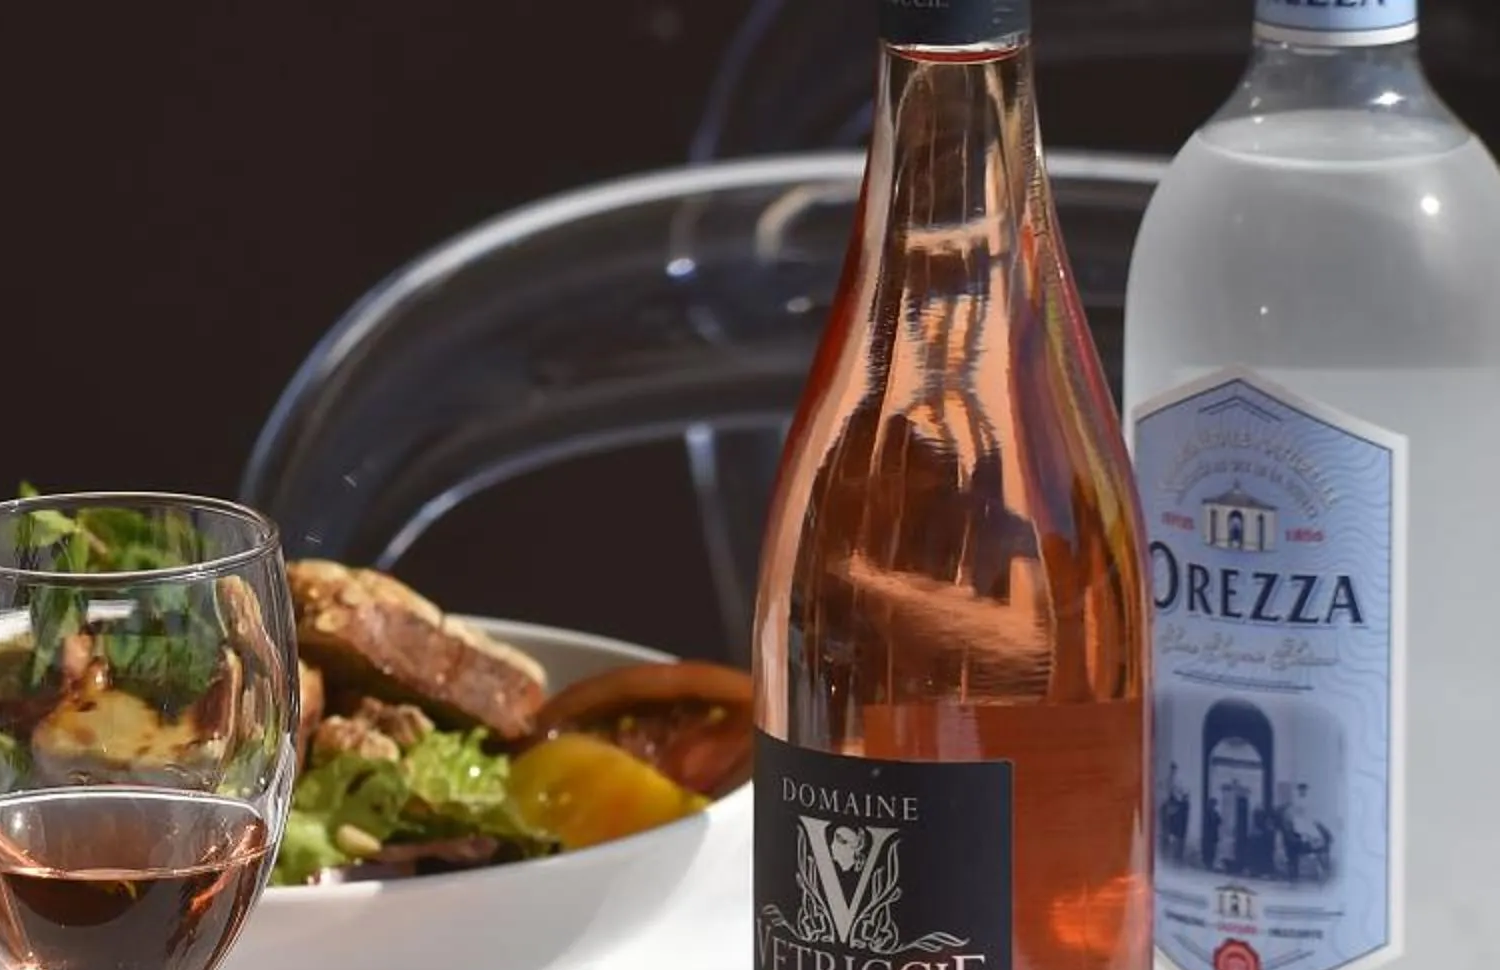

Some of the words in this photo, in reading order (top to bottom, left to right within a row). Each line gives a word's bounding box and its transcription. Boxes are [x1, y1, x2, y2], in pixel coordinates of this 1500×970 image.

[1150, 540, 1364, 625] OREZZA
[782, 776, 919, 821] DOMAINE
[799, 815, 900, 944] V
